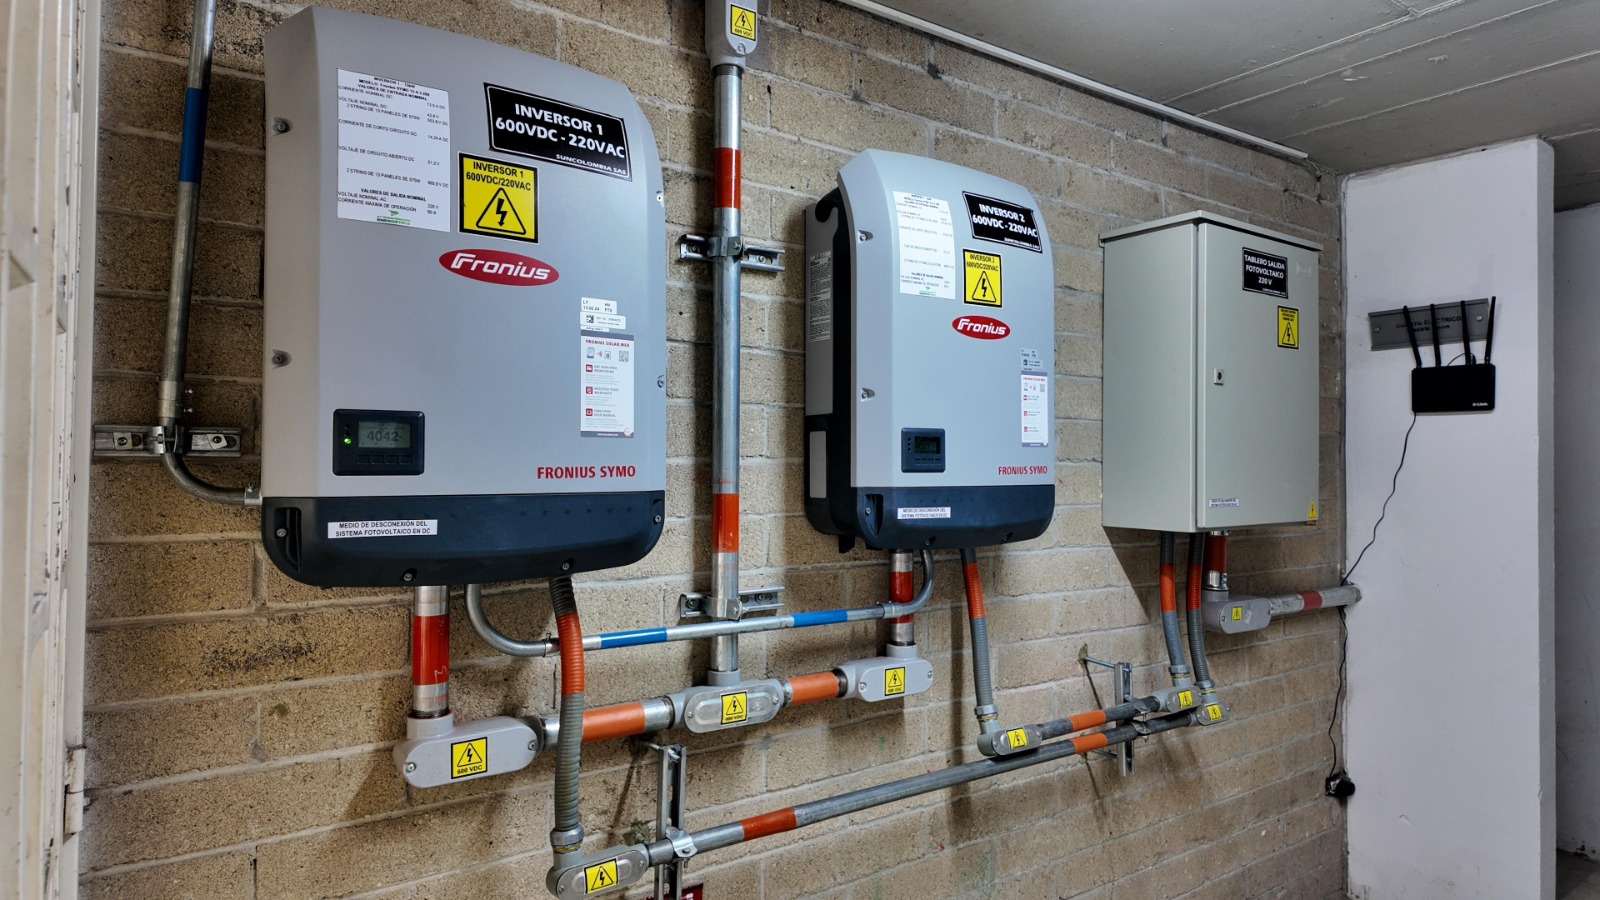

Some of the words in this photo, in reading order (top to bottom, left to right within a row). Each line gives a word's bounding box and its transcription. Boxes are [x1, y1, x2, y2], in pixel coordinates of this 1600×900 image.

[338, 85, 364, 93] CORRIENTE
[365, 90, 384, 98] NOMINAL
[387, 88, 407, 96] ENTRADA
[360, 100, 379, 108] NOMINAL
[381, 109, 401, 117] PANELES
[515, 104, 592, 133] INVERSOR
[596, 124, 602, 135] 1
[338, 118, 365, 127] CORRIENTE
[389, 127, 410, 135] CIRCUITO
[495, 117, 558, 142] 600VDC
[568, 134, 625, 158] 220VAC
[367, 149, 388, 157] CIRCUITO
[473, 162, 517, 177] INVERSOR
[556, 154, 612, 171] SUNCOLOMBIA
[613, 167, 626, 175] SAS
[466, 172, 531, 191] 600VDC/220VAC
[338, 197, 364, 205] CORRIENTE
[979, 204, 1019, 221] INVERSOR
[1019, 214, 1025, 222] 2
[972, 214, 1004, 229] 600VDC
[1008, 222, 1038, 237] 220VAC
[970, 254, 991, 262] INVERSOR
[1244, 254, 1267, 266] TABLERO
[1268, 259, 1285, 270] SALIDA
[450, 252, 551, 280] Fronius
[1246, 264, 1284, 279] FOTOVOLTAICO
[957, 318, 1006, 335] Fronius
[367, 430, 399, 442] 4042
[537, 466, 596, 479] FRONIUS
[600, 465, 636, 478] SYMO
[998, 466, 1027, 475] FRONIUS
[1029, 466, 1048, 474] SYMO
